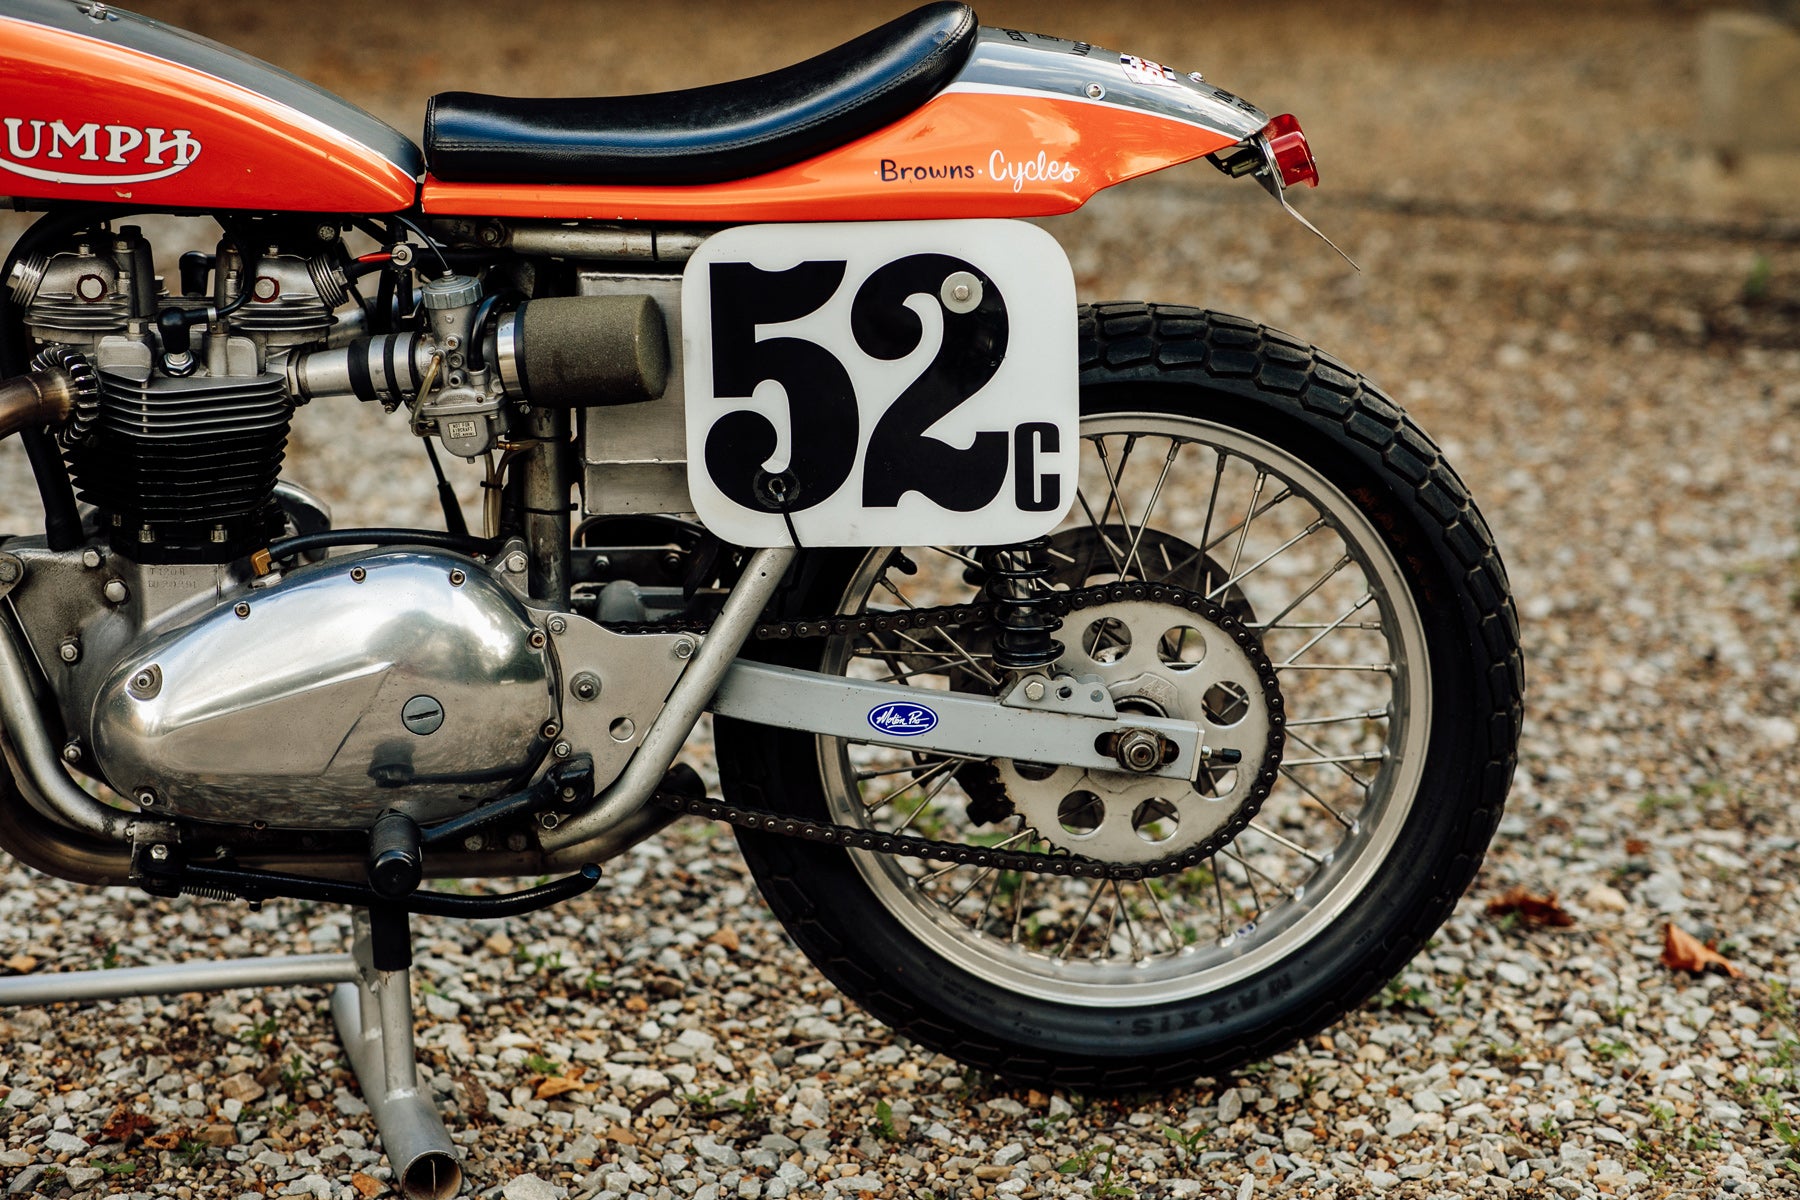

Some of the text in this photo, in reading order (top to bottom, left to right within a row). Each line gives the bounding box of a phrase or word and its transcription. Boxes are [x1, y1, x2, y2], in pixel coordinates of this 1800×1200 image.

[3, 117, 202, 166] UMPH
[880, 149, 1080, 193] Browns Cycles
[907, 710, 930, 725] Pro
[1131, 972, 1293, 1036] MAXXIS
